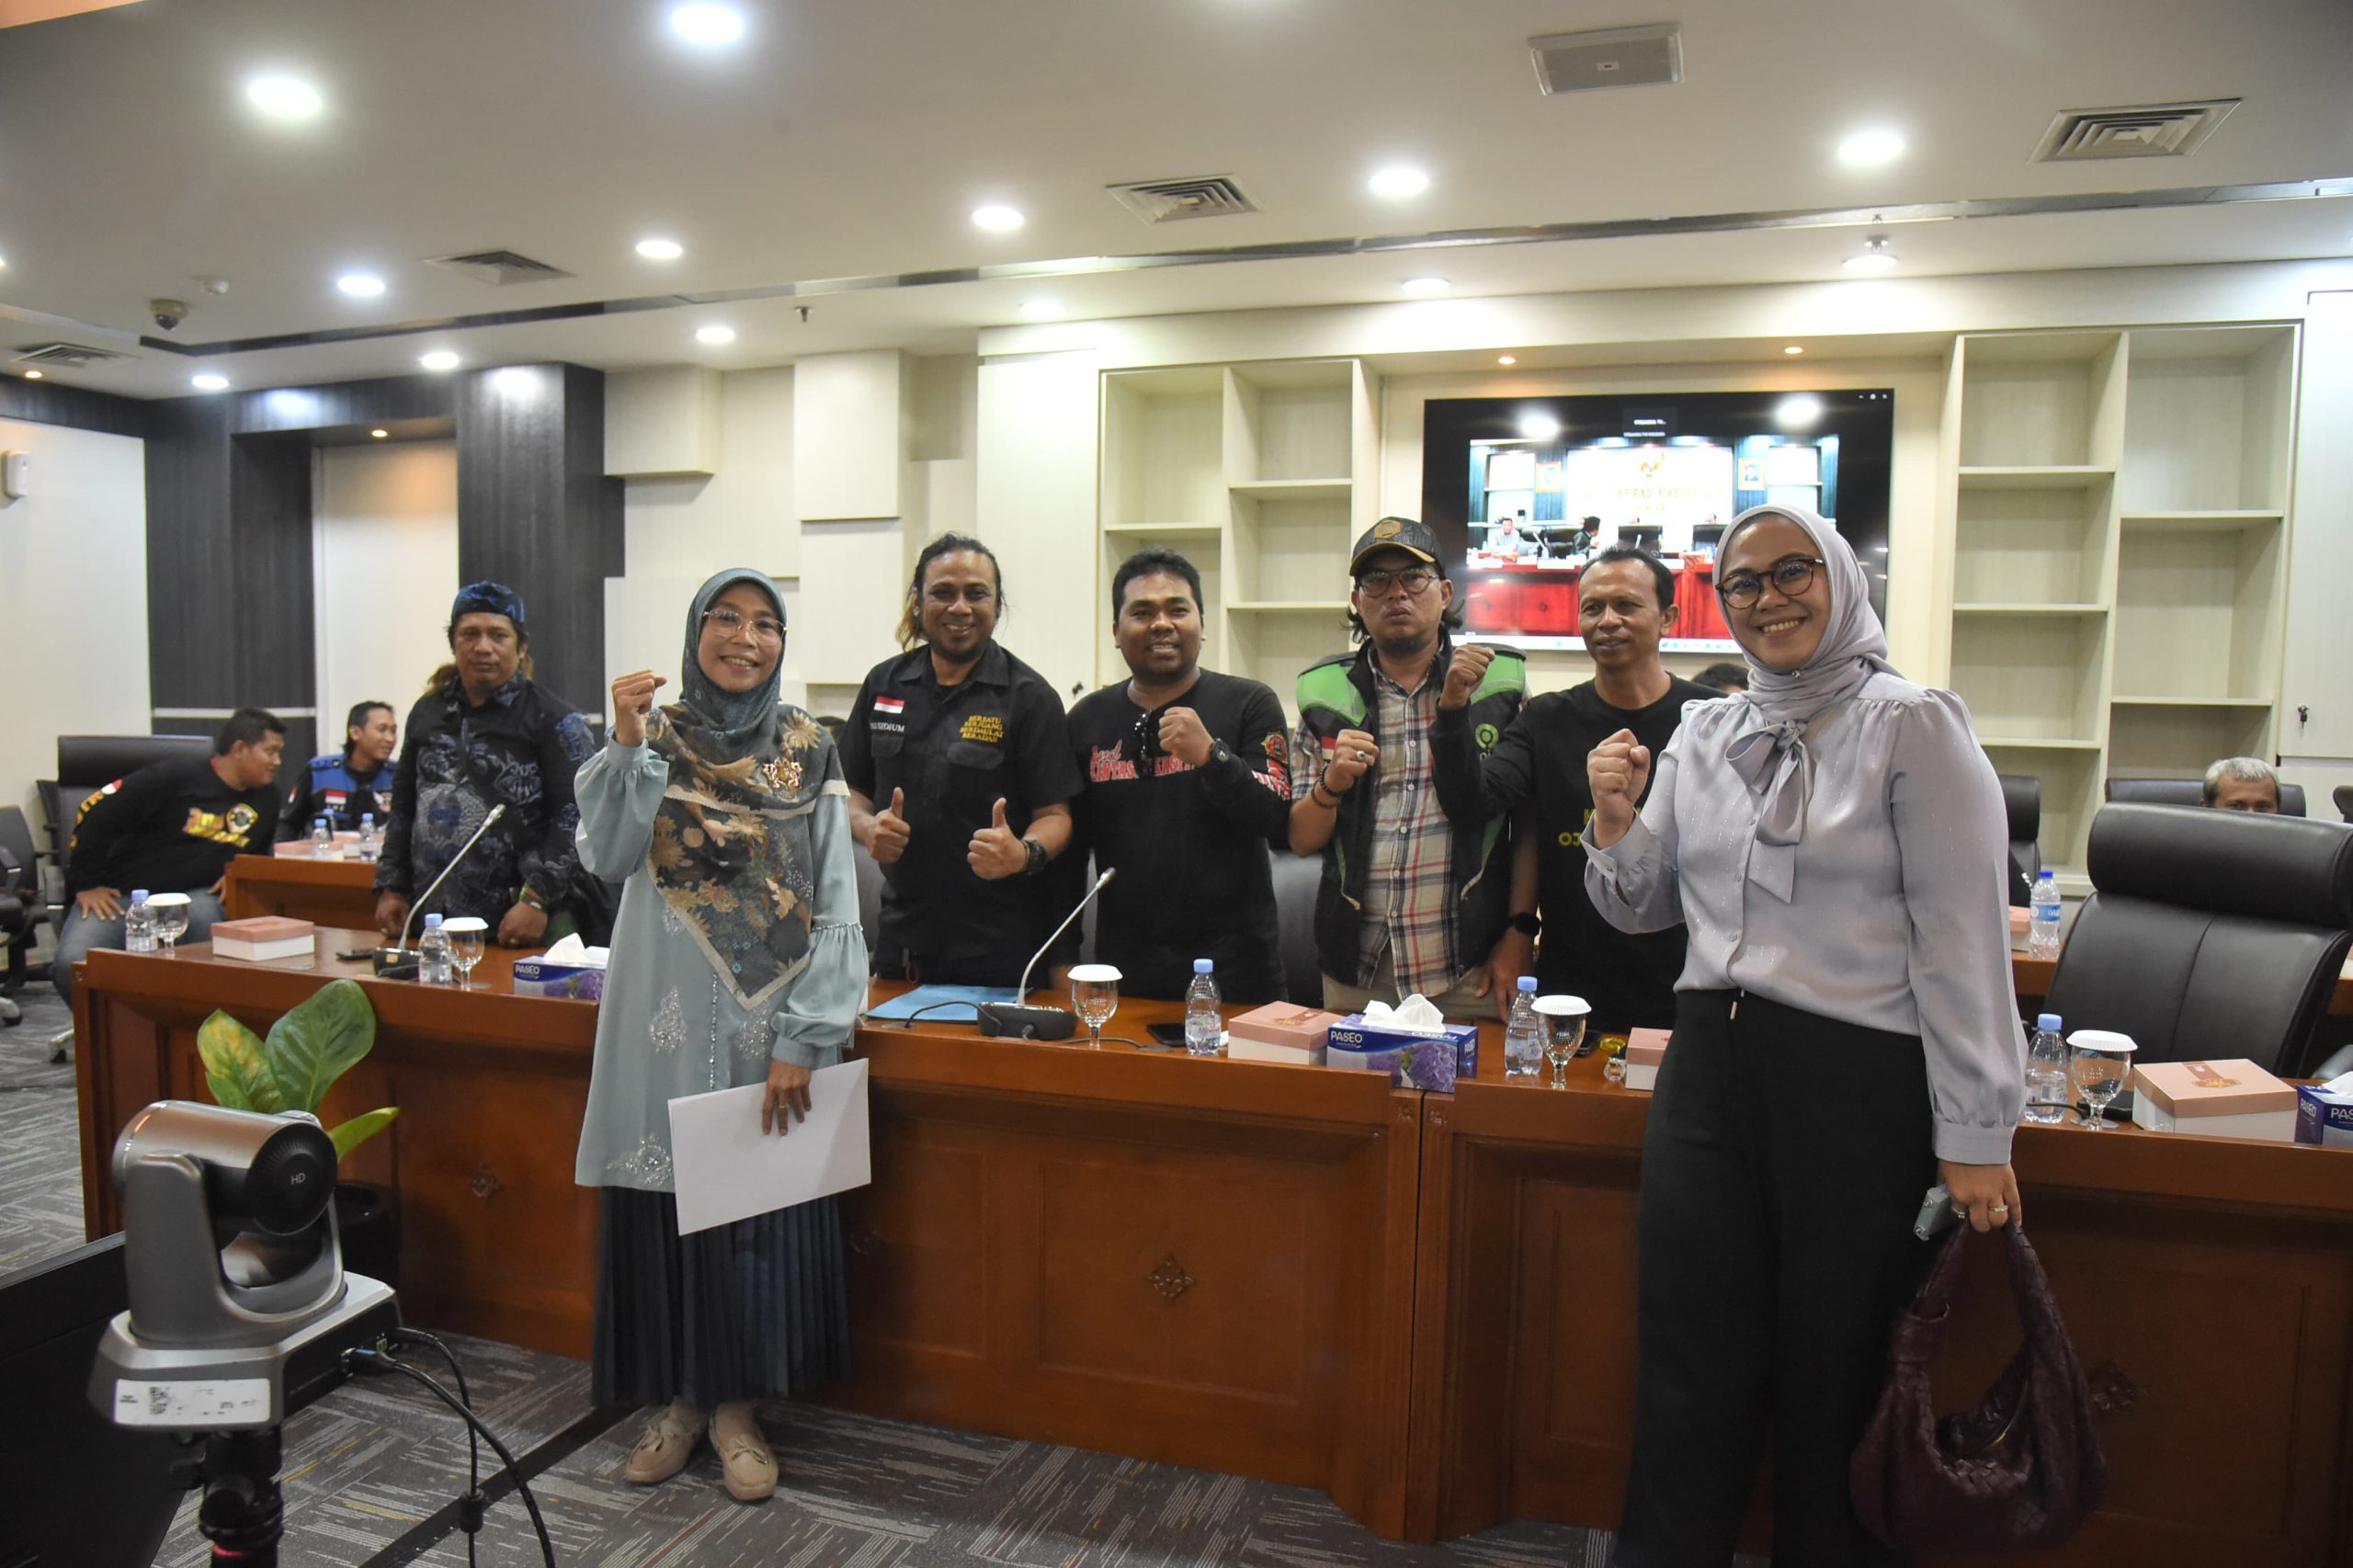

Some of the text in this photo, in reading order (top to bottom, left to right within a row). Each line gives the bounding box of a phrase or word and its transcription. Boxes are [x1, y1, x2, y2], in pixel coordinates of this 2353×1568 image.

[968, 715, 1001, 724] BERSATU
[960, 727, 1004, 737] BERDAULAT
[964, 722, 1003, 731] BERJUANG
[1559, 832, 1582, 846] OJ
[515, 964, 540, 975] PASEO
[1331, 1030, 1363, 1044] PASEO
[291, 1173, 305, 1185] HD
